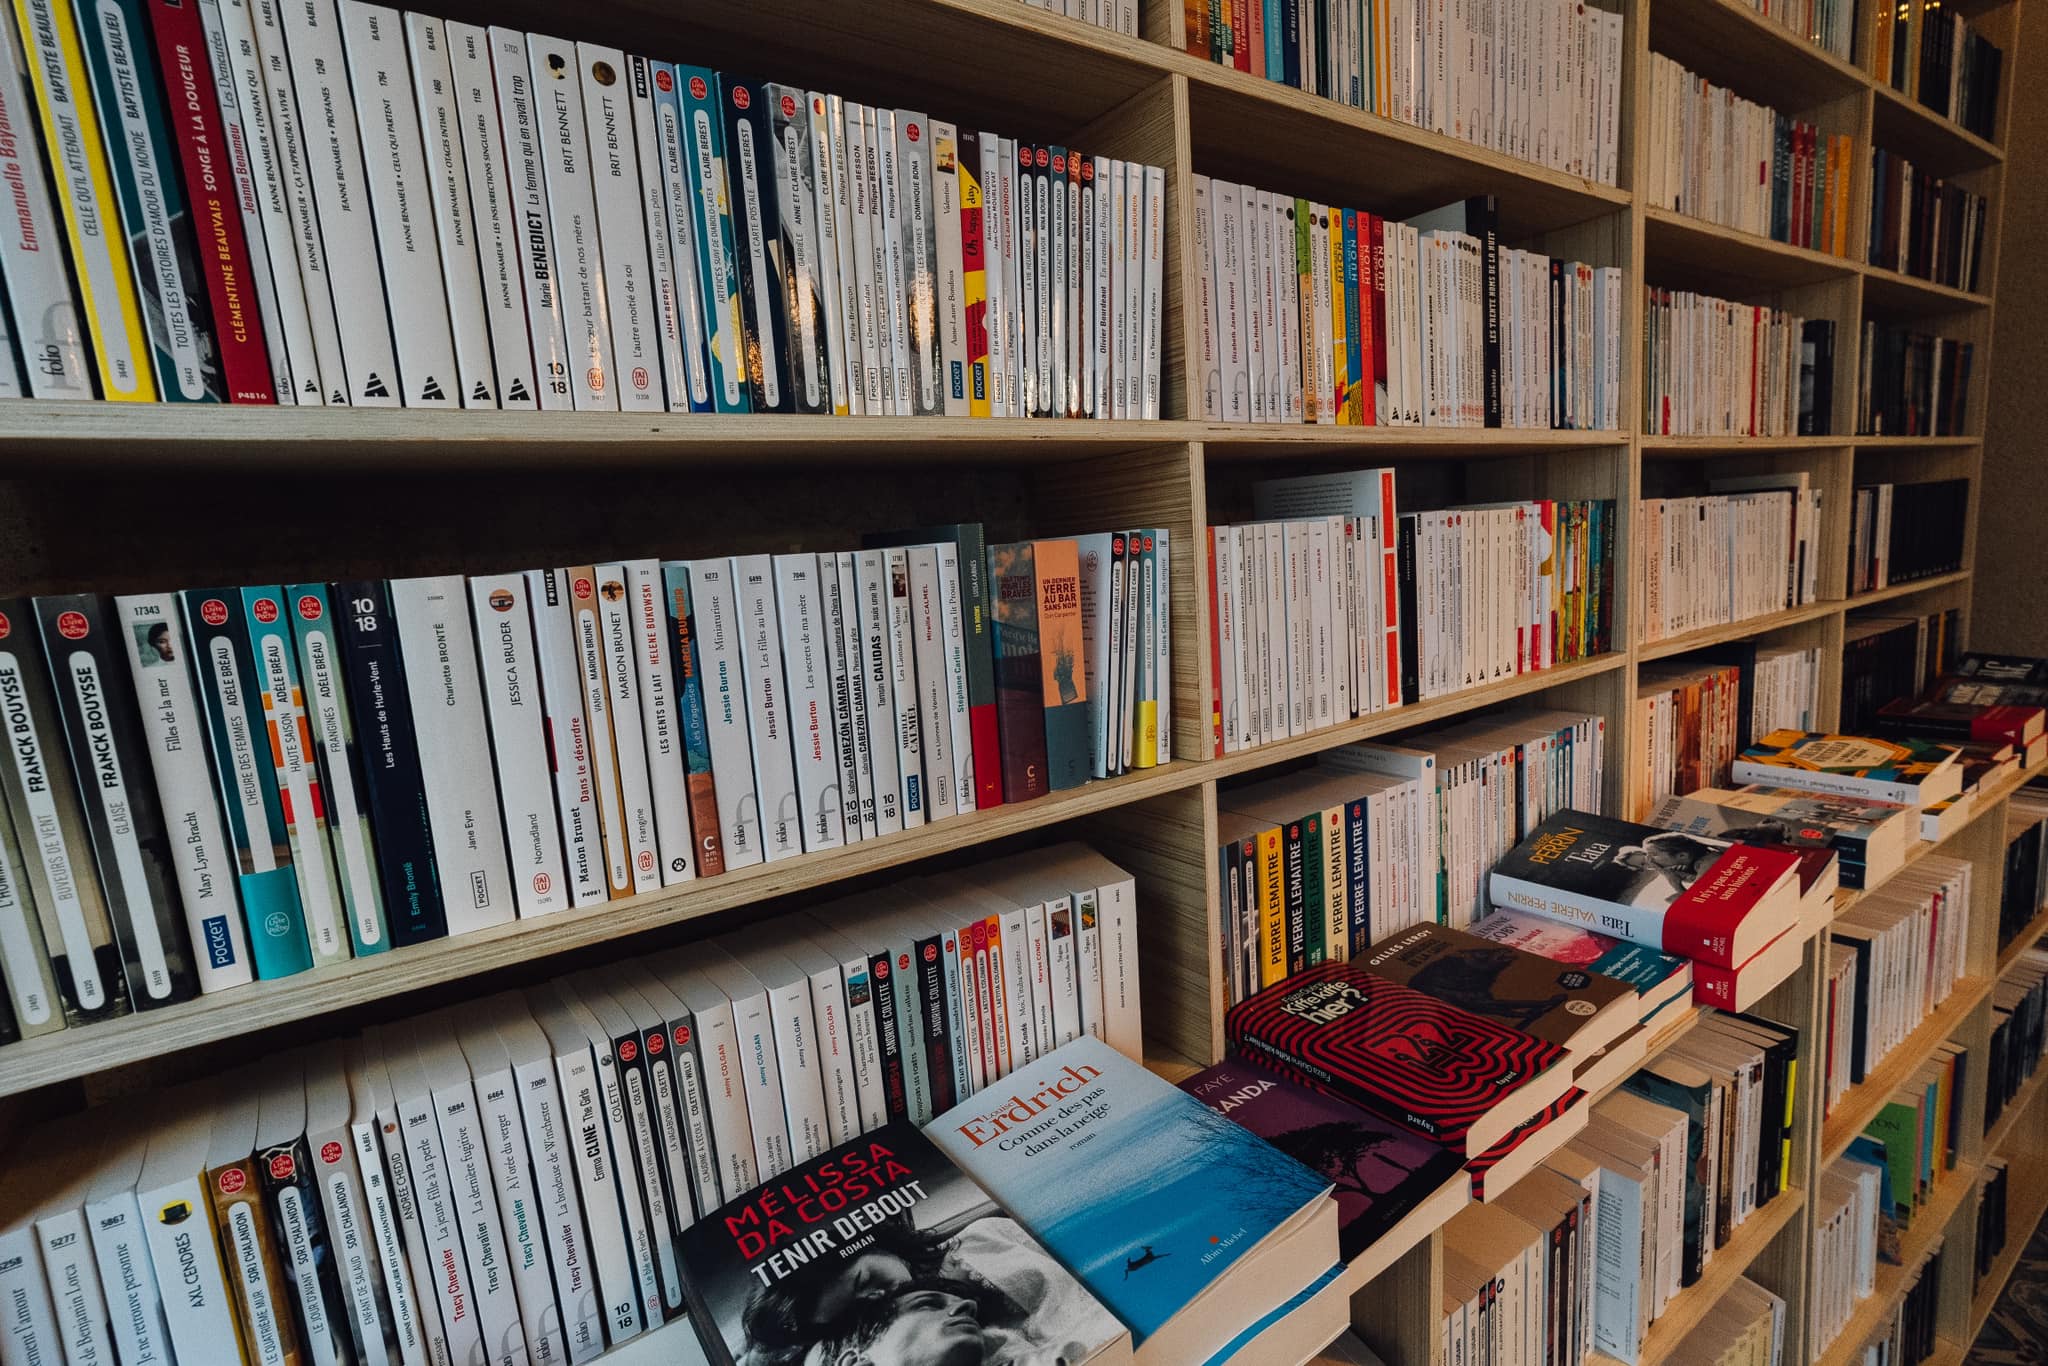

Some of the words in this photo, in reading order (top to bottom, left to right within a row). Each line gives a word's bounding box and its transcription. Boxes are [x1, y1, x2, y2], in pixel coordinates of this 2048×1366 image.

[104, 12, 127, 65] BEAULIEU
[368, 15, 380, 41] BABEL
[43, 49, 69, 103] BAPTISTE
[211, 31, 234, 90] Demeurées
[118, 66, 140, 119] BAPTISTE
[176, 45, 200, 111] DOUCEUR
[511, 75, 526, 95] trop
[223, 92, 236, 109] Les
[516, 98, 529, 127] savait
[192, 116, 205, 132] LA
[554, 90, 572, 145] BENNETT
[664, 113, 676, 145] BEREST
[60, 115, 81, 173] ATTENDAIT
[130, 130, 150, 162] MONDE
[227, 123, 249, 174] Benameur
[519, 128, 530, 140] en
[520, 141, 535, 157] qui
[196, 146, 217, 191] SONGE
[564, 147, 576, 174] BRIT
[668, 146, 680, 174] CLAIRE
[854, 144, 863, 181] BESSON
[72, 176, 92, 204] QU'IL
[141, 170, 156, 188] DU
[524, 160, 540, 193] femme
[237, 178, 257, 214] Jeanne
[527, 194, 540, 206] La
[857, 182, 865, 215] Philippe
[78, 205, 98, 236] CELLE
[143, 193, 166, 235] D'AMOUR
[207, 200, 231, 260] BEAUVAIS
[527, 210, 549, 280] BENEDICT
[154, 238, 177, 290] HISTOIRES
[166, 291, 180, 309] LES
[221, 264, 248, 343] CLÉMENTINE
[536, 282, 553, 308] Marie
[171, 311, 188, 348] TOUTES
[547, 362, 565, 375] 10
[952, 363, 963, 398] POCKET
[550, 381, 568, 394] 18
[1043, 583, 1076, 594] VERRE
[1044, 595, 1056, 603] AU
[1058, 593, 1076, 602] BAR
[134, 606, 160, 616] 17343
[352, 599, 375, 613] 10
[643, 584, 657, 630] BUKOWSKI
[355, 617, 377, 632] 18
[610, 611, 626, 655] BRUNET
[712, 595, 725, 651] Miniaturiste
[312, 642, 327, 671] BRÉAU
[432, 623, 450, 662] BRONTË
[500, 621, 517, 663] BRUDER
[268, 646, 284, 675] BRÉAU
[872, 635, 884, 682] CALIDAS
[158, 678, 169, 694] mer
[272, 676, 287, 703] ADÈLE
[317, 671, 331, 698] ADÈLE
[369, 661, 386, 710] Hurle-Vent
[442, 664, 456, 706] Charlotte
[508, 667, 523, 706] JESSICA
[616, 657, 630, 699] MARION
[652, 673, 662, 693] LAIT
[719, 661, 730, 691] Burton
[0, 667, 30, 733] BOUYSSE
[77, 667, 106, 730] BOUYSSE
[162, 699, 172, 709] la
[655, 695, 664, 706] DE
[723, 689, 734, 724] Jessie
[162, 712, 175, 724] de
[281, 713, 295, 745] SAISON
[324, 707, 341, 753] FRANGINES
[377, 710, 387, 722] de
[657, 708, 668, 736] DENTS
[810, 700, 819, 731] Burton
[164, 726, 182, 752] Filles
[379, 723, 392, 751] Hauts
[571, 717, 586, 762] désordre
[661, 738, 670, 754] LES
[813, 732, 822, 761] Jessie
[16, 736, 46, 793] FRANCK
[94, 733, 119, 788] FRANCK
[287, 747, 301, 772] HAUTE
[385, 753, 395, 768] Les
[576, 766, 586, 776] le
[580, 778, 590, 802] Dans
[109, 801, 129, 835] GLAISE
[184, 811, 201, 843] Bracht
[572, 806, 584, 843] Brunet
[528, 814, 544, 865] Nomadland
[1529, 826, 1585, 865] PERRIN
[1564, 842, 1612, 864] Tata
[194, 846, 209, 873] Lynn
[577, 845, 590, 883] Marion
[199, 874, 213, 900] Mary
[1508, 891, 1547, 910] PERRIN
[1333, 891, 1343, 935] PIERRE
[1354, 884, 1365, 925] PIERRE
[1551, 903, 1598, 924] VALÉRIE
[213, 919, 230, 964] POCKET
[1271, 919, 1282, 965] PIERRE
[1293, 906, 1303, 953] PIERRE
[1601, 915, 1635, 938] Tata
[1369, 944, 1404, 966] GILLES
[1405, 928, 1433, 946] LEROY
[1194, 1073, 1235, 1096] FAYE
[607, 1081, 624, 1123] COLETTE
[954, 1064, 1104, 1151] Erdrich
[982, 1101, 1016, 1122] Louise
[998, 1117, 1058, 1151] Comme
[1058, 1102, 1083, 1120] des
[1082, 1087, 1106, 1107] pas
[1024, 1134, 1060, 1157] dans
[1059, 1126, 1073, 1139] la
[1073, 1102, 1112, 1129] neige
[582, 1123, 602, 1158] CLINE
[1069, 1132, 1097, 1150] roman
[724, 1142, 895, 1237] MÉLISSA
[736, 1219, 794, 1260] DA
[796, 1160, 912, 1224] COSTA
[235, 1211, 257, 1266] CHALANDON
[476, 1221, 498, 1264] Chevalier
[751, 1229, 837, 1288] TENIR
[832, 1180, 929, 1242] DEBOUT
[839, 1234, 876, 1258] ROMAN
[1200, 1246, 1223, 1265] Albin
[1221, 1227, 1247, 1251] Michel
[174, 1232, 200, 1283] CENDRES
[441, 1248, 461, 1295] Chevalier
[247, 1267, 261, 1284] SORJ
[487, 1264, 502, 1295] Tracy
[189, 1285, 206, 1308] AXL
[449, 1291, 466, 1322] Tracy
